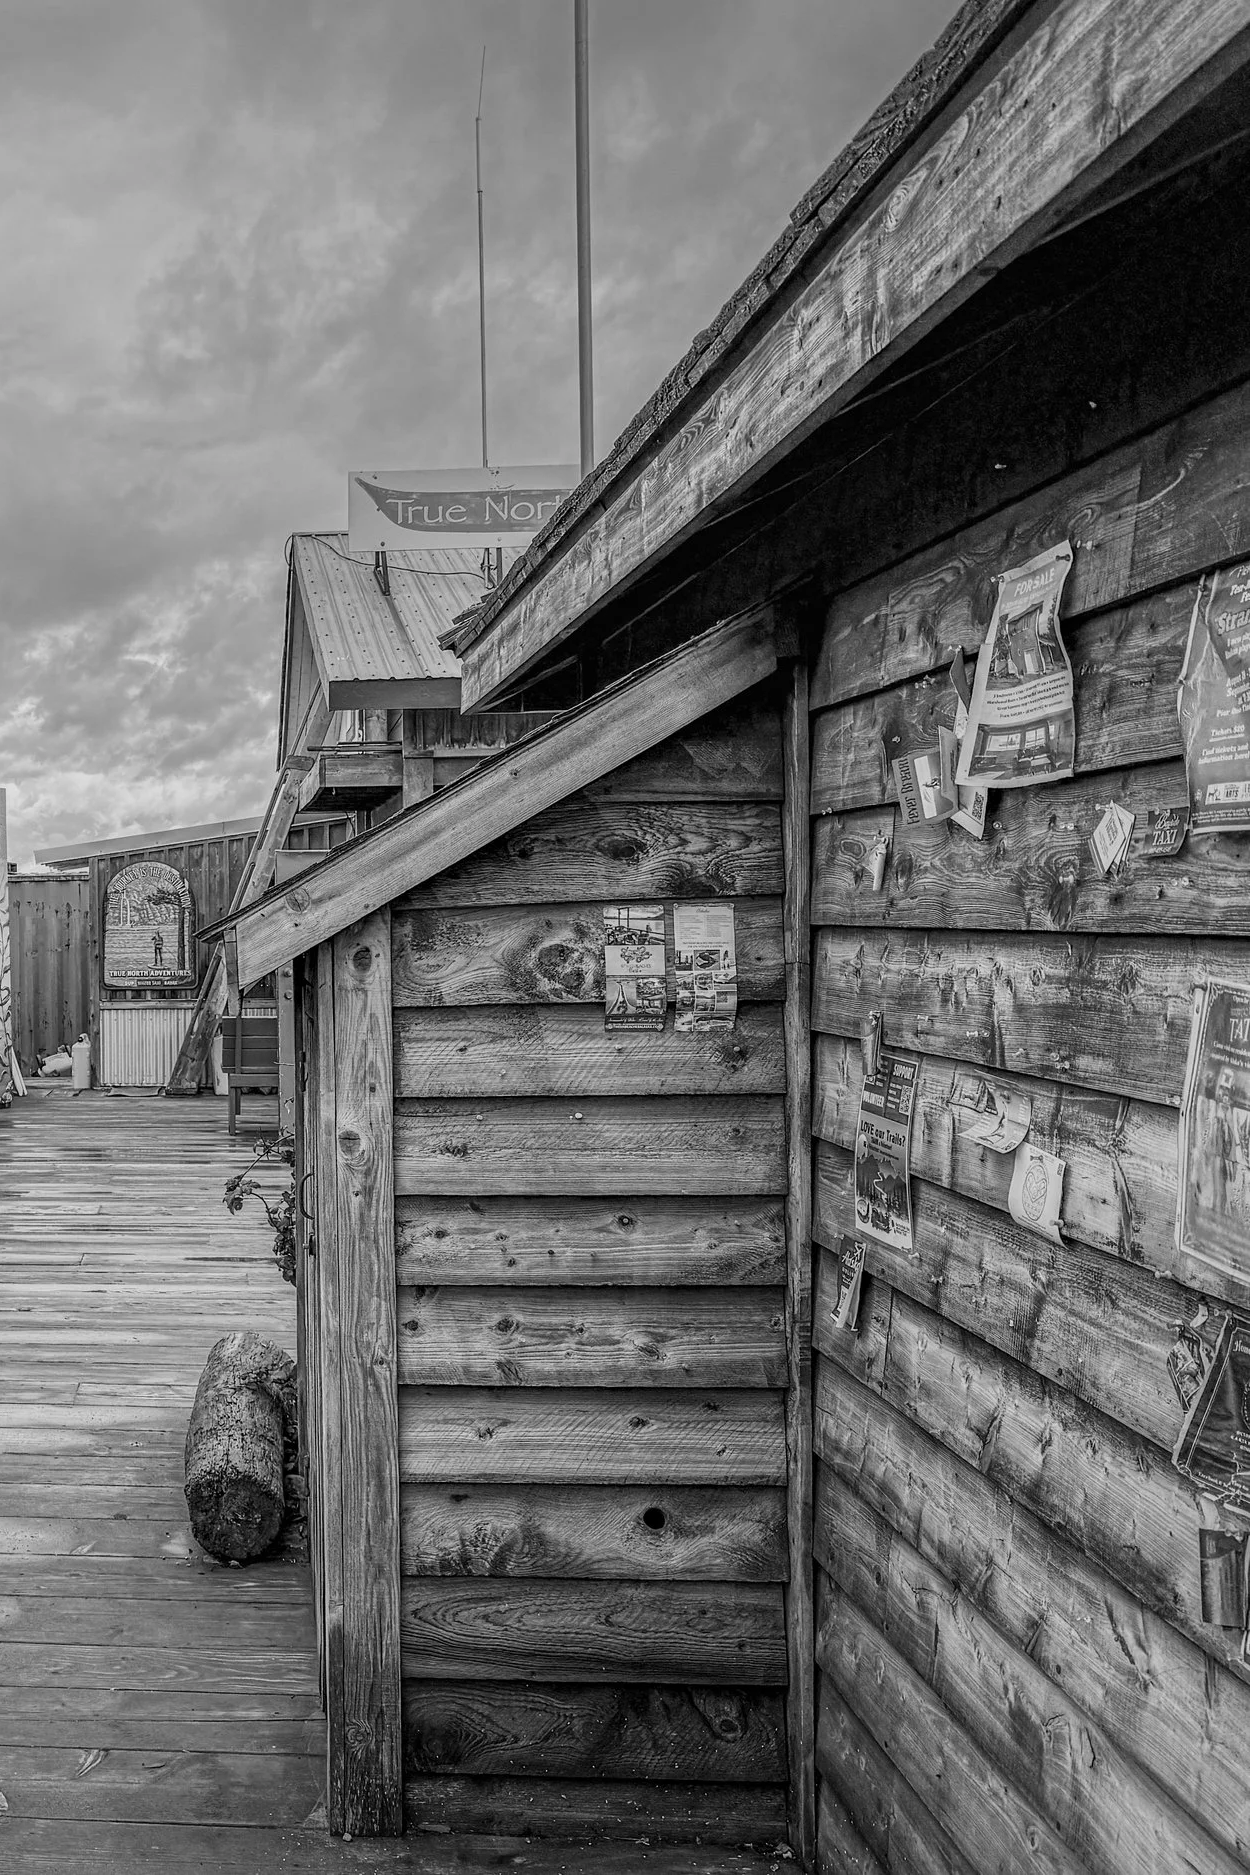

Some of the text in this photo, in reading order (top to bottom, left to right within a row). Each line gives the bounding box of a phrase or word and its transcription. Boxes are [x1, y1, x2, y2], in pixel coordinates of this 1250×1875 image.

[385, 495, 561, 525] True Nort
[1014, 567, 1055, 597] FOR SALE
[1152, 829, 1178, 846] TAXI
[150, 866, 163, 878] THE
[893, 1063, 914, 1081] SUPPORT
[860, 1119, 875, 1136] LOVE
[886, 1129, 906, 1148] Trails?
